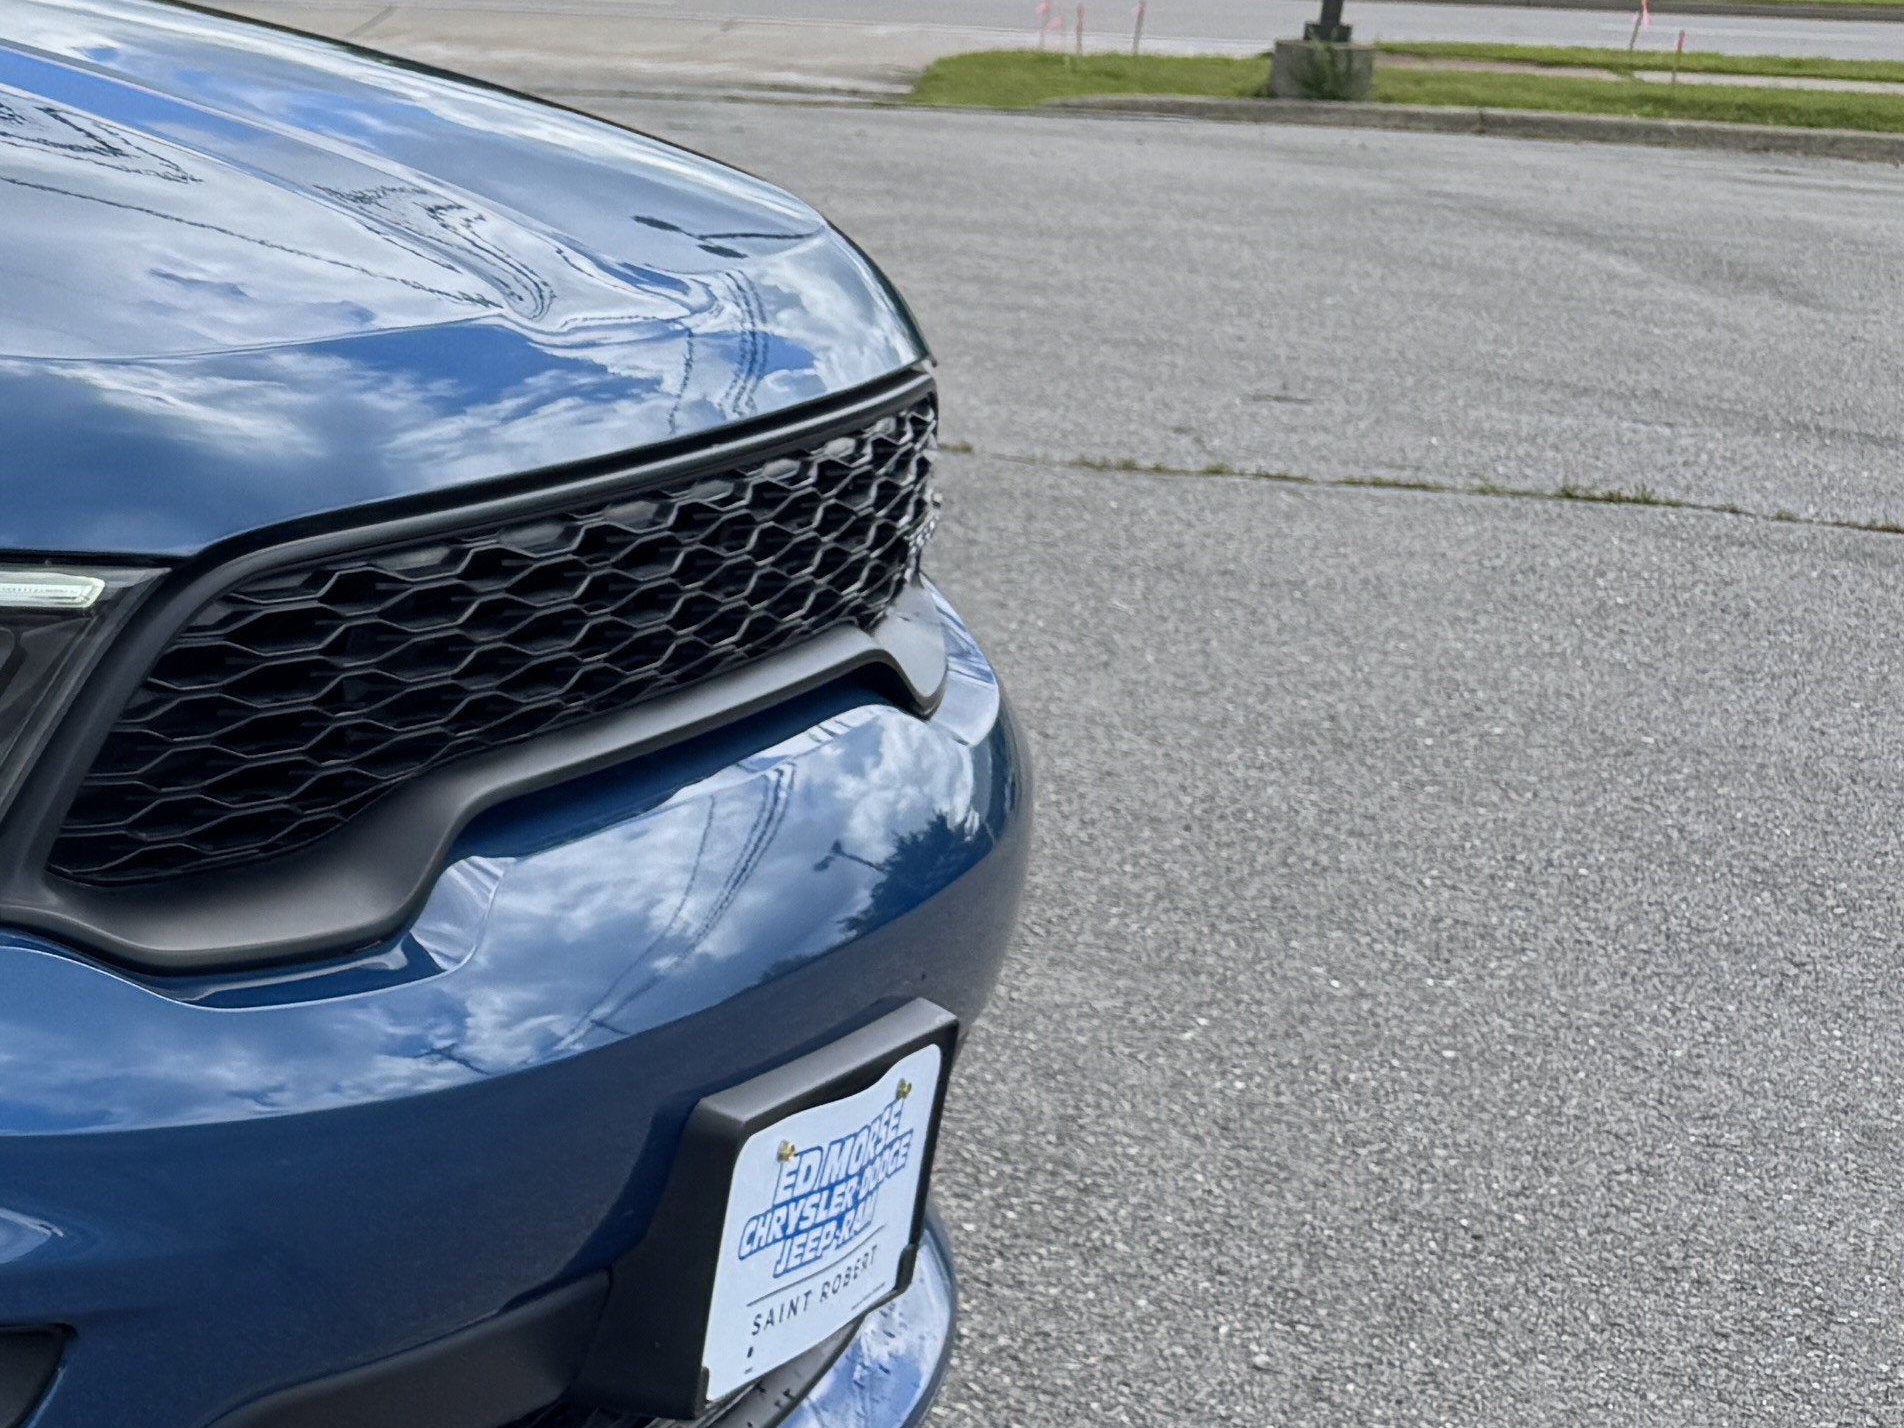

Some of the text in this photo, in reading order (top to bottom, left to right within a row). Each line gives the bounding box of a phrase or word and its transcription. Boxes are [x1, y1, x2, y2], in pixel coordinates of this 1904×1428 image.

[773, 1098, 903, 1207] ED MORSE
[751, 1244, 878, 1336] SAINT ROBERT
